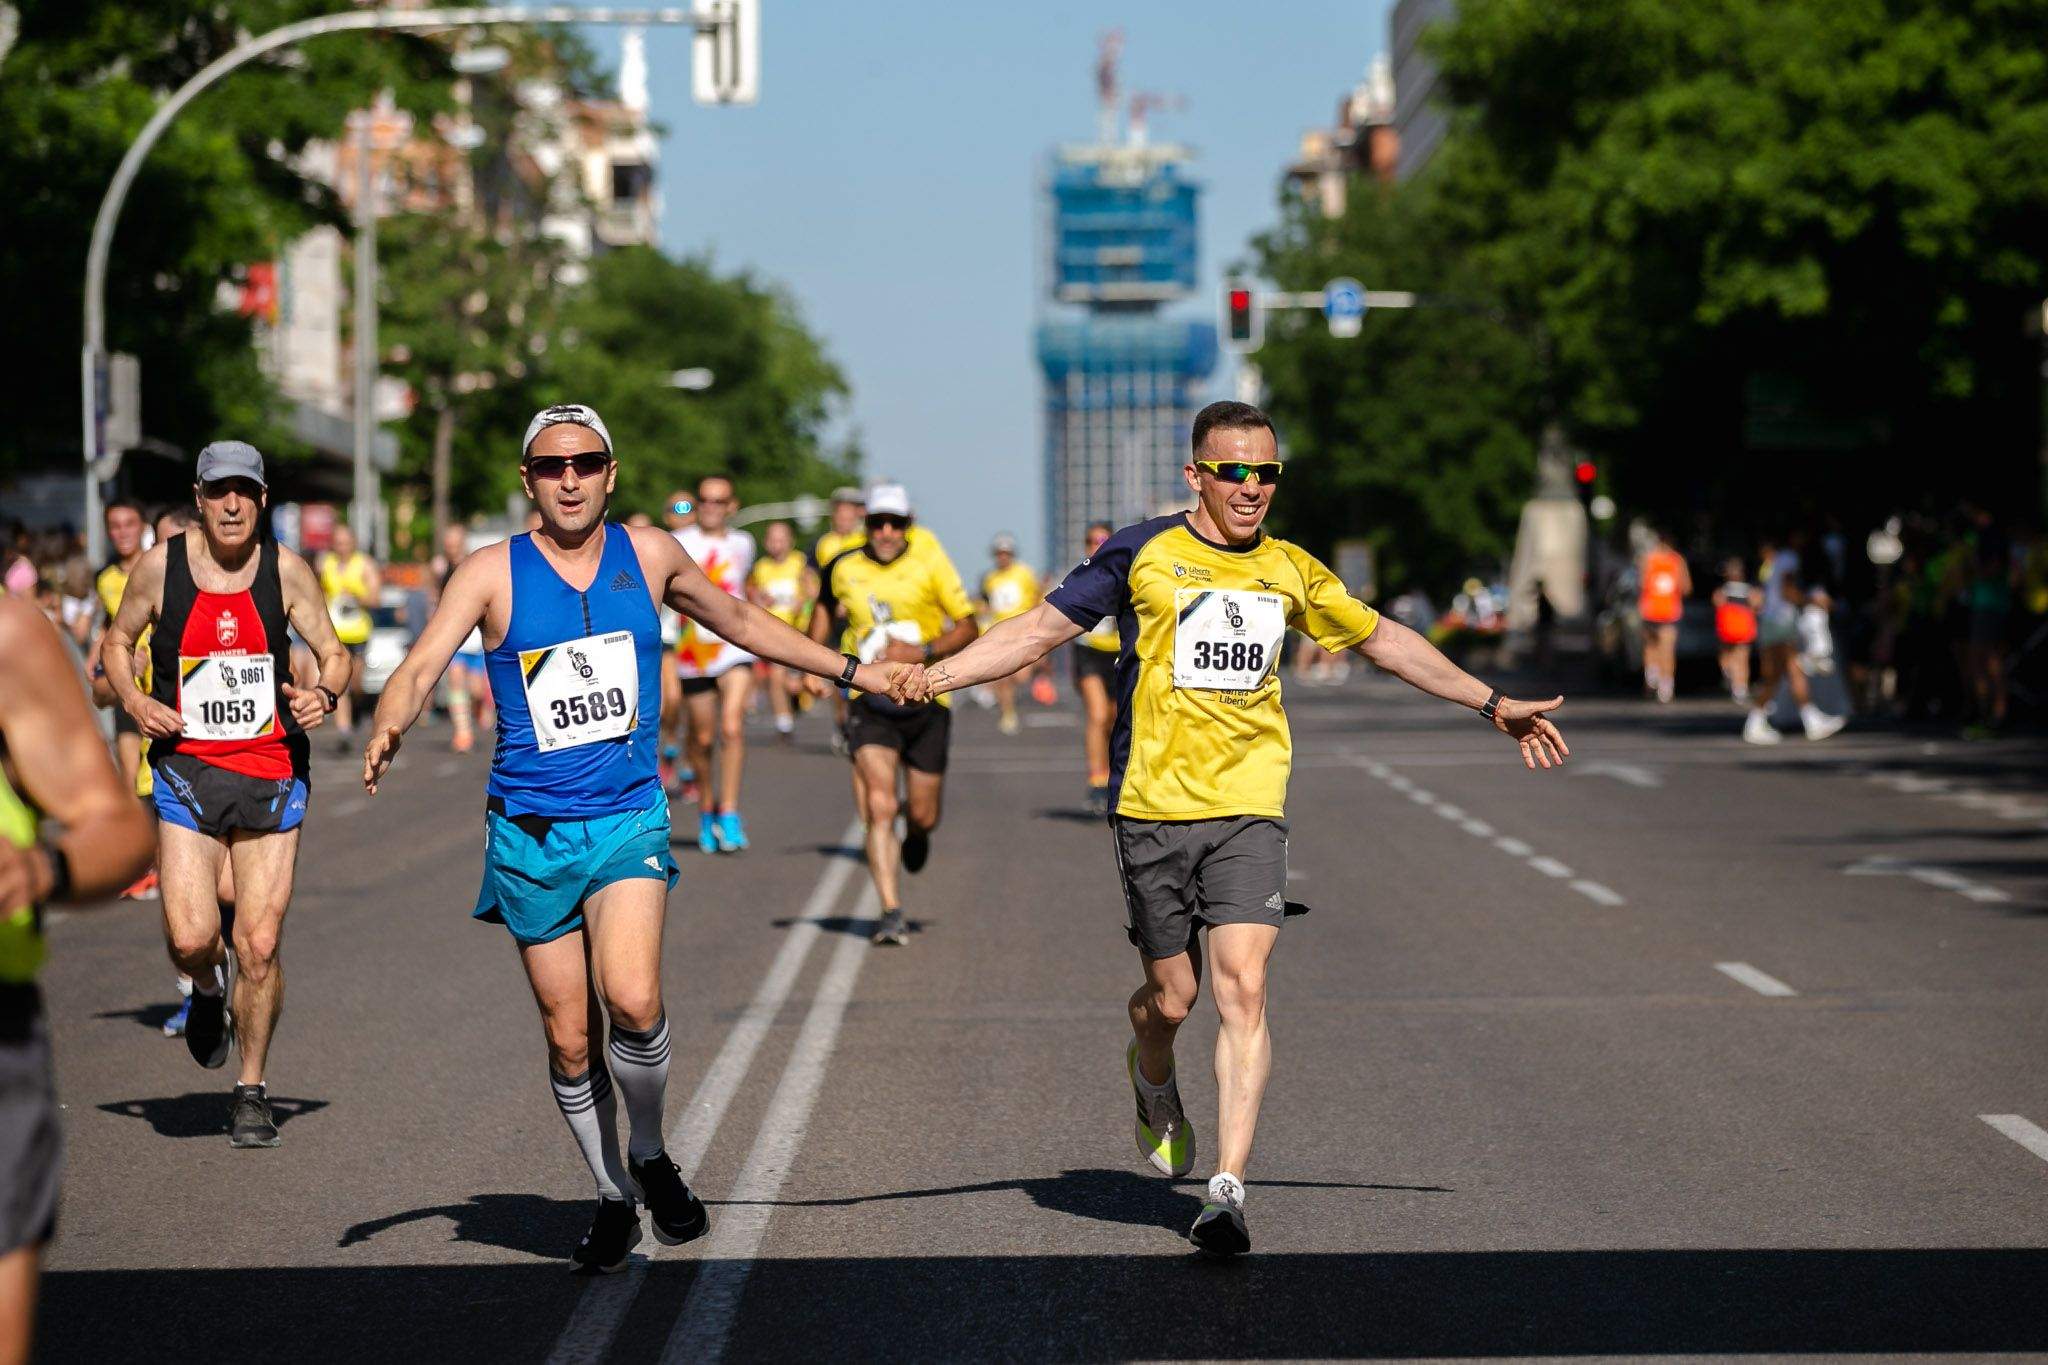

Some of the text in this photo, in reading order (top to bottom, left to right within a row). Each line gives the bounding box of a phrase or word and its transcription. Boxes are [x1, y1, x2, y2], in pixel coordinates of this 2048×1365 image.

[611, 580, 640, 591] adidas
[1194, 641, 1263, 671] 3588
[241, 667, 264, 684] 9861
[550, 688, 626, 729] 3589
[1219, 695, 1248, 706] Liberty
[199, 699, 255, 725] 1053
